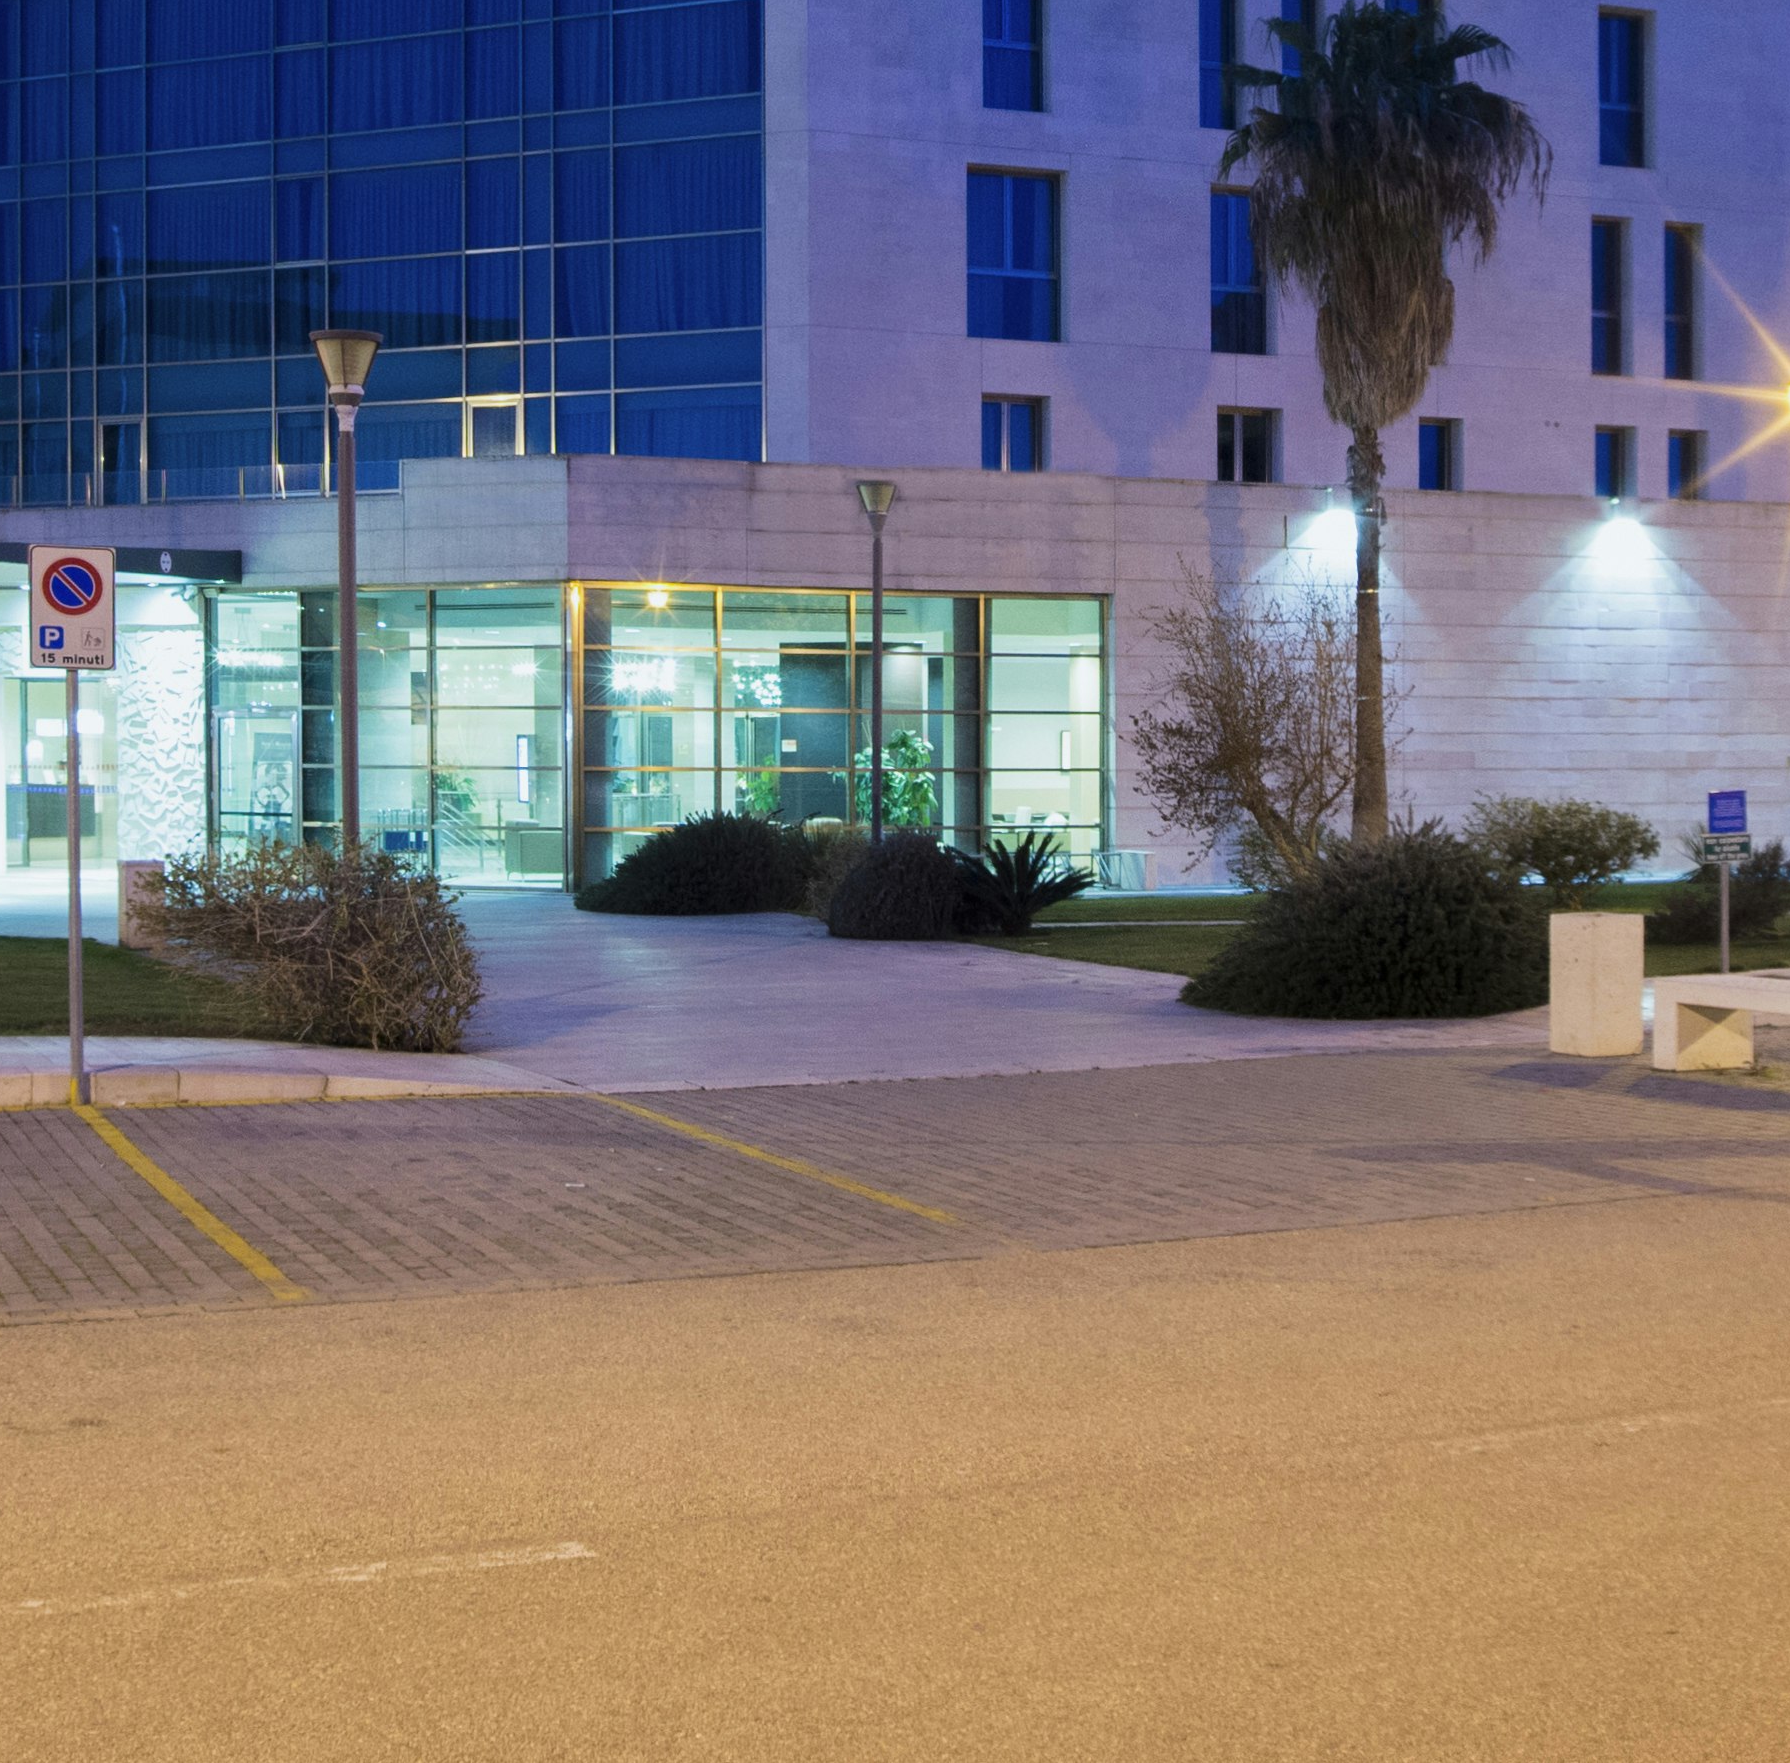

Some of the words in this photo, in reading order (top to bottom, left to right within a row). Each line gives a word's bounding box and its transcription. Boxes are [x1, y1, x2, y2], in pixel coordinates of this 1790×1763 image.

[44, 628, 60, 647] P
[41, 653, 56, 663] 15
[62, 654, 105, 665] minuti
